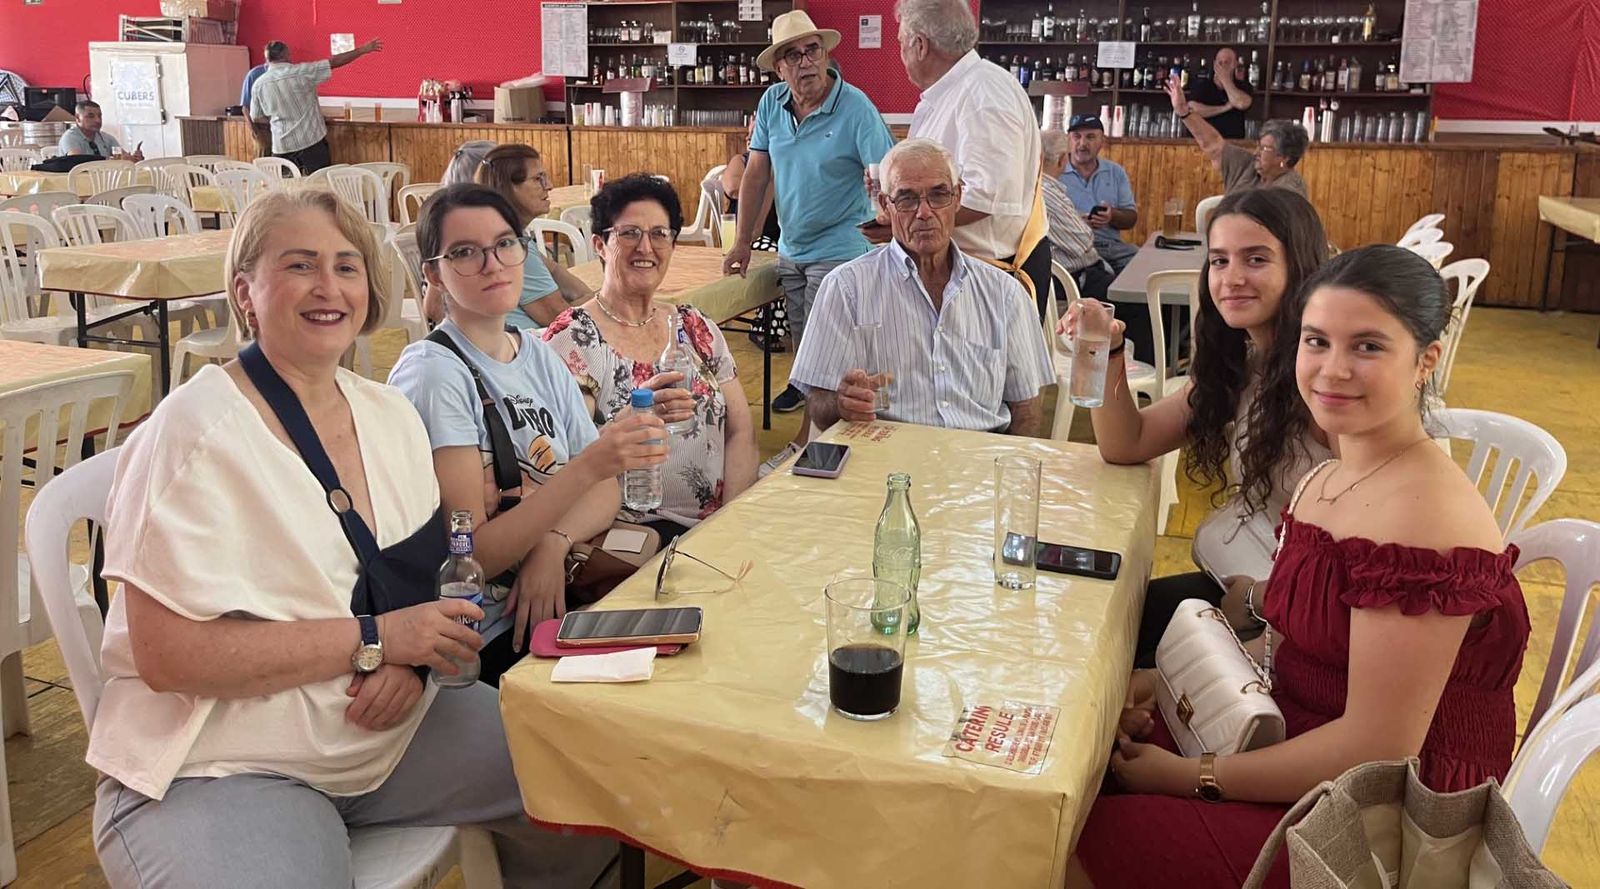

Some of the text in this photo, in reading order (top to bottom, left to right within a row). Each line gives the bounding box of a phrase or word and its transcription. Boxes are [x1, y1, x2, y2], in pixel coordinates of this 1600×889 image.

[117, 91, 155, 101] CUBERS
[507, 395, 533, 407] Disney
[955, 706, 992, 752] CATERIN
[985, 712, 1013, 753] RESULE
